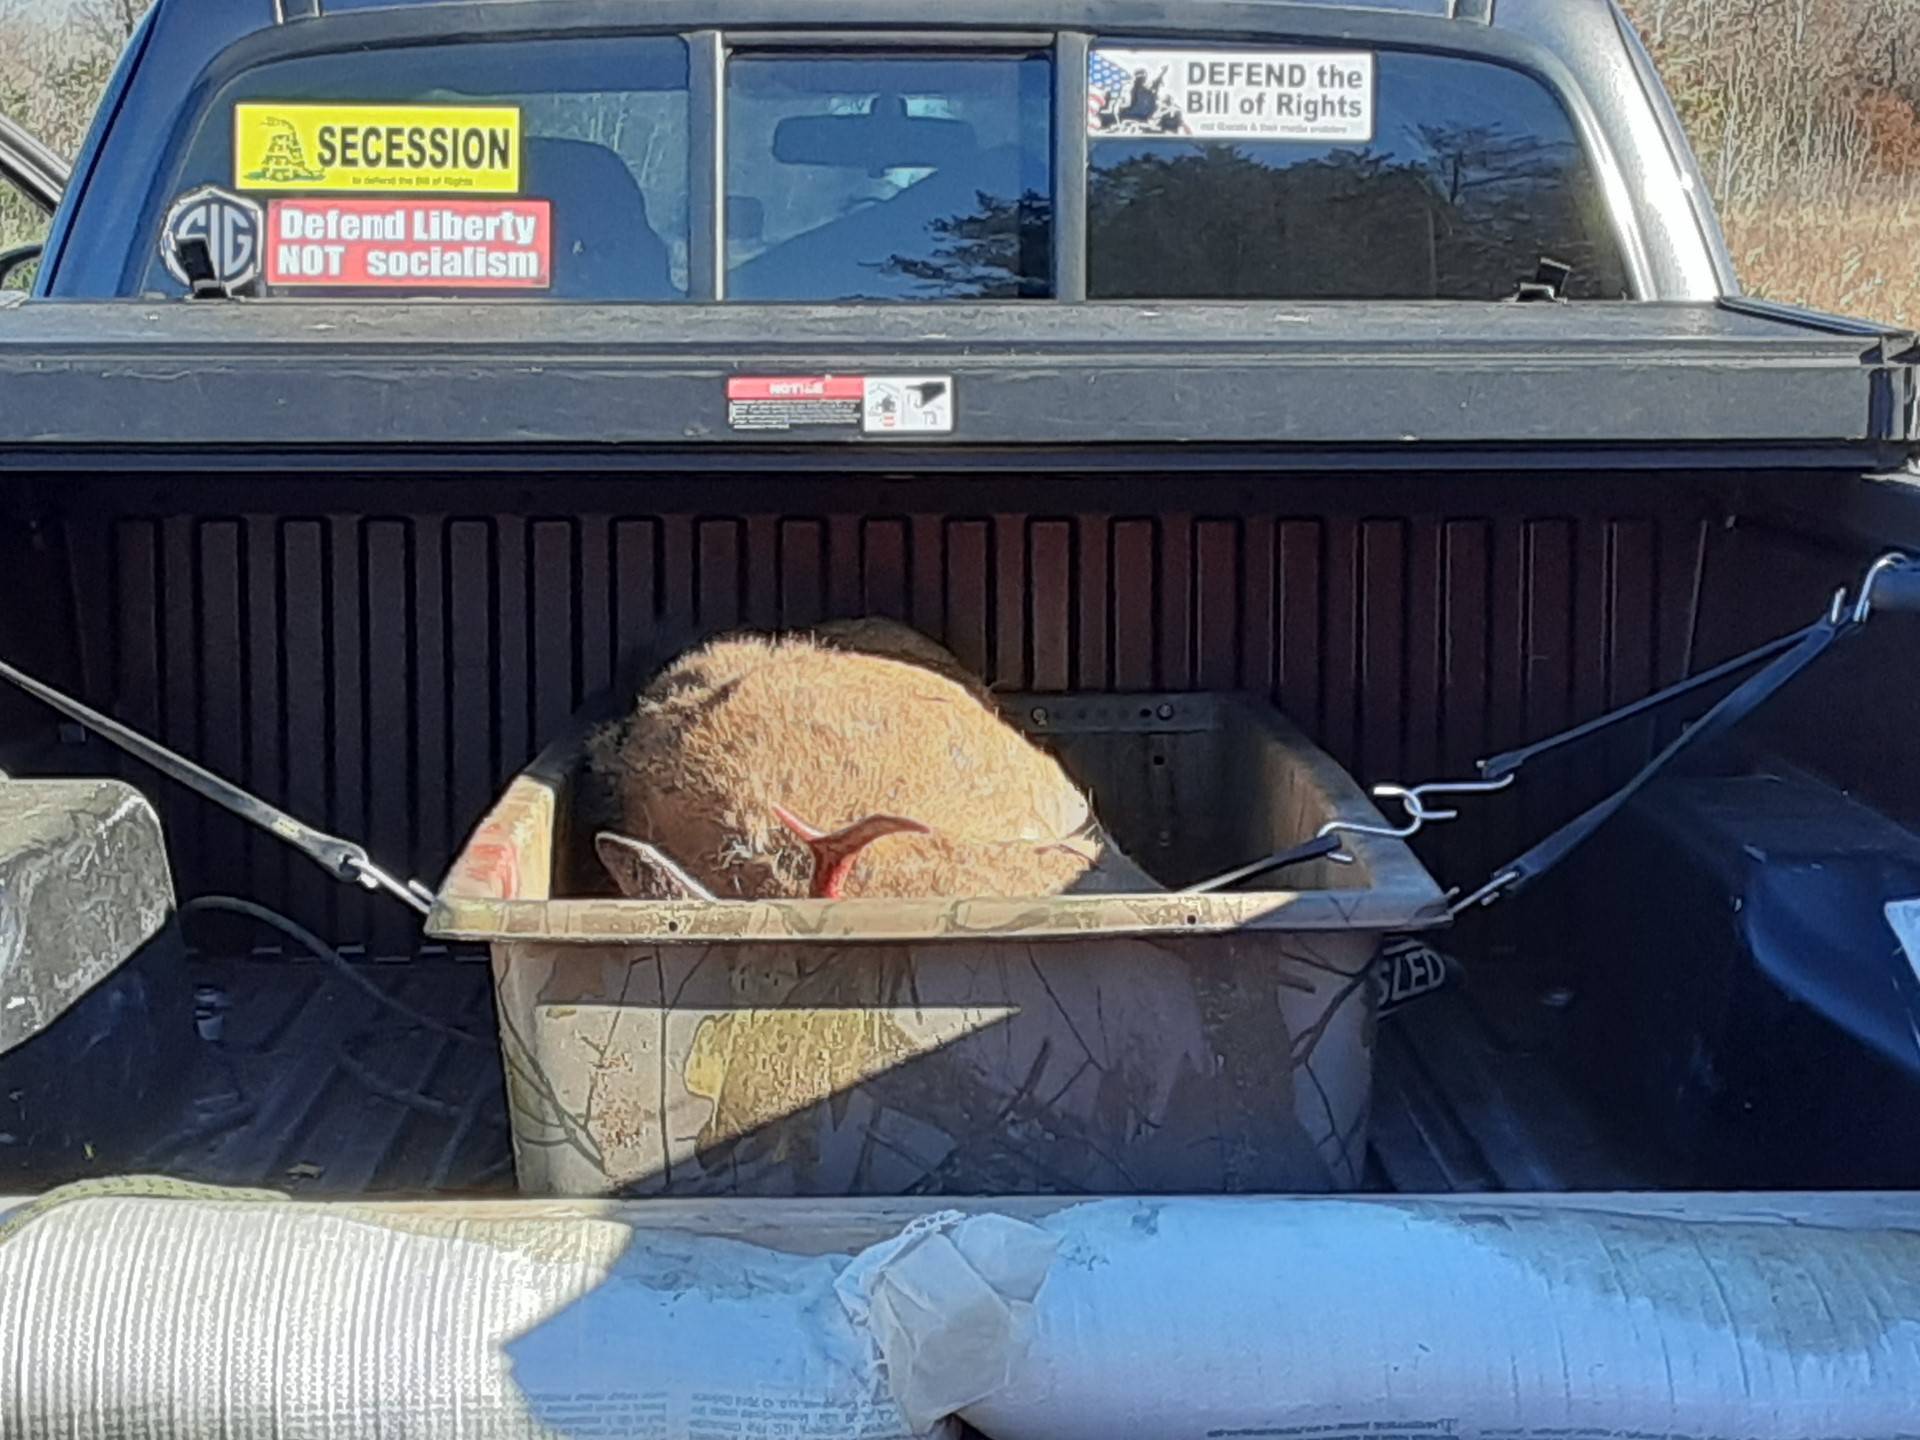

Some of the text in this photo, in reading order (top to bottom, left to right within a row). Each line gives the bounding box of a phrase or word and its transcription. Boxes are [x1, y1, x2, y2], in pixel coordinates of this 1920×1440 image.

[1187, 62, 1363, 89] DEFEND the
[1186, 91, 1362, 121] Bill of Rights
[317, 126, 511, 169] SECESSION
[280, 208, 536, 245] Defend Liberty
[277, 246, 539, 278] NOT socialism
